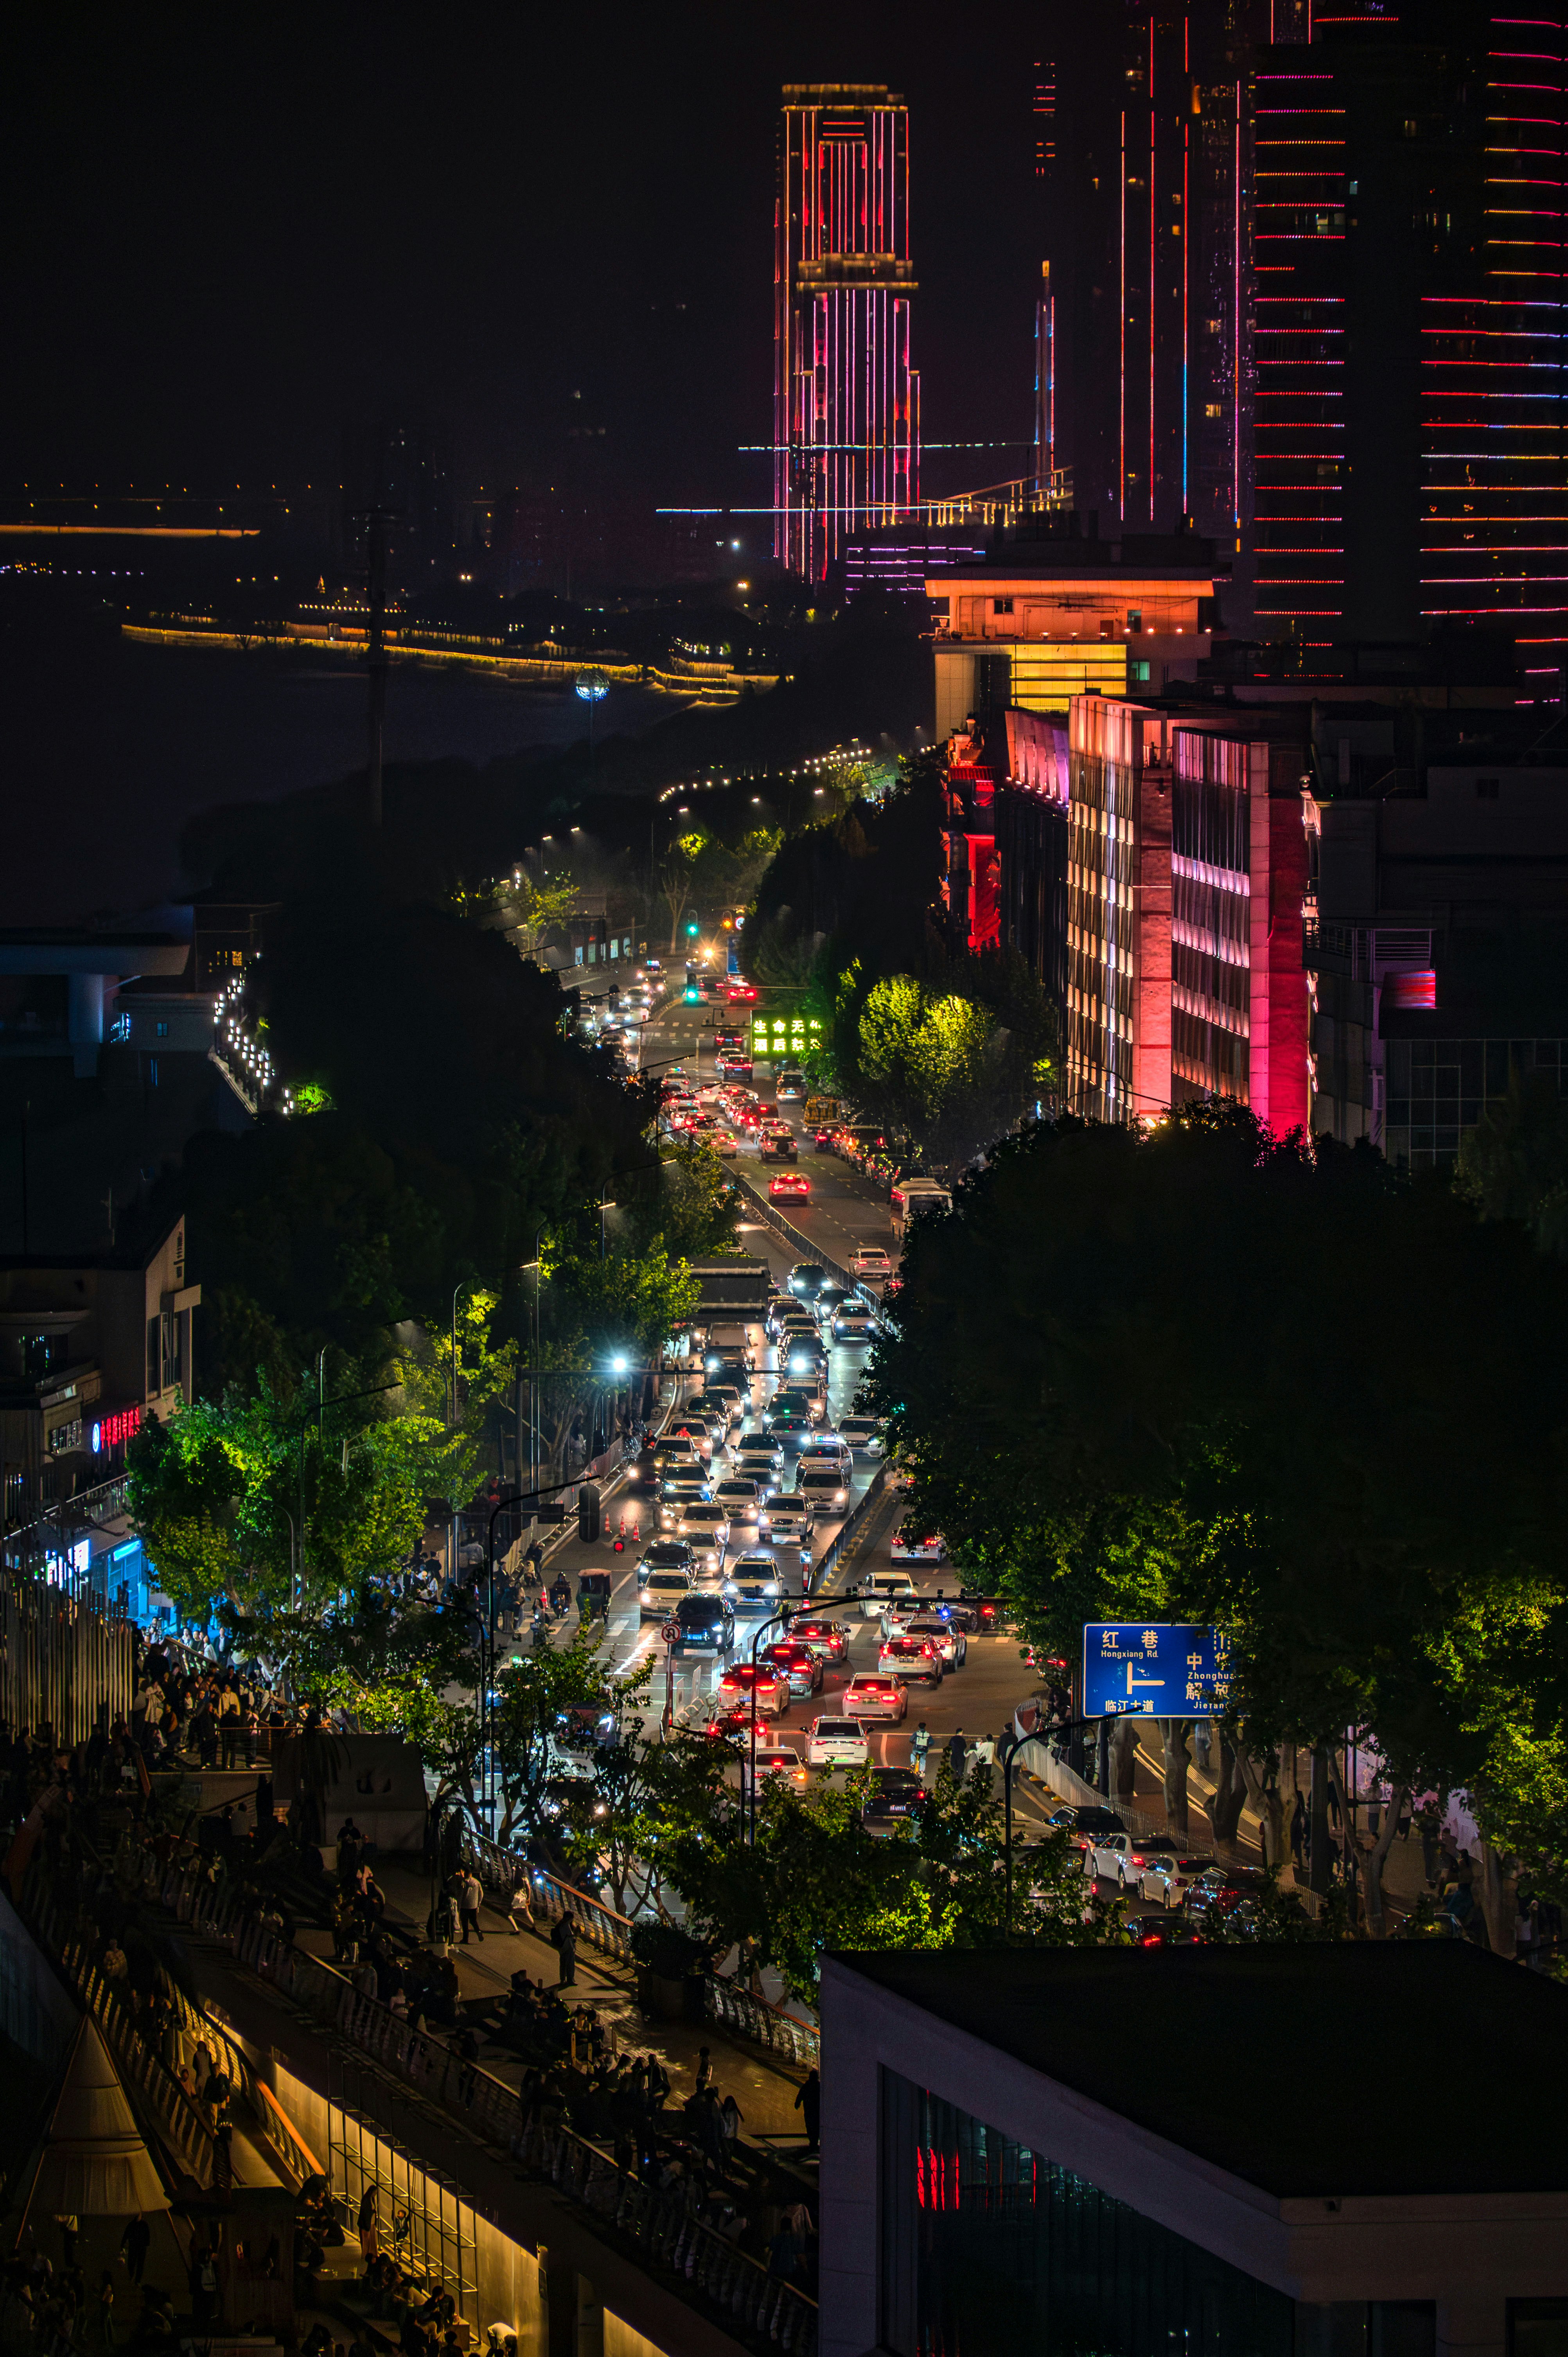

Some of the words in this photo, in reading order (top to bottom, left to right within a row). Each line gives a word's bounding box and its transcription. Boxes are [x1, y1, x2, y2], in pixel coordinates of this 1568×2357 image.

[1102, 1630, 1158, 1649] 红巷
[1101, 1650, 1143, 1659] Hongxiang
[1105, 1699, 1154, 1712] 临江大道
